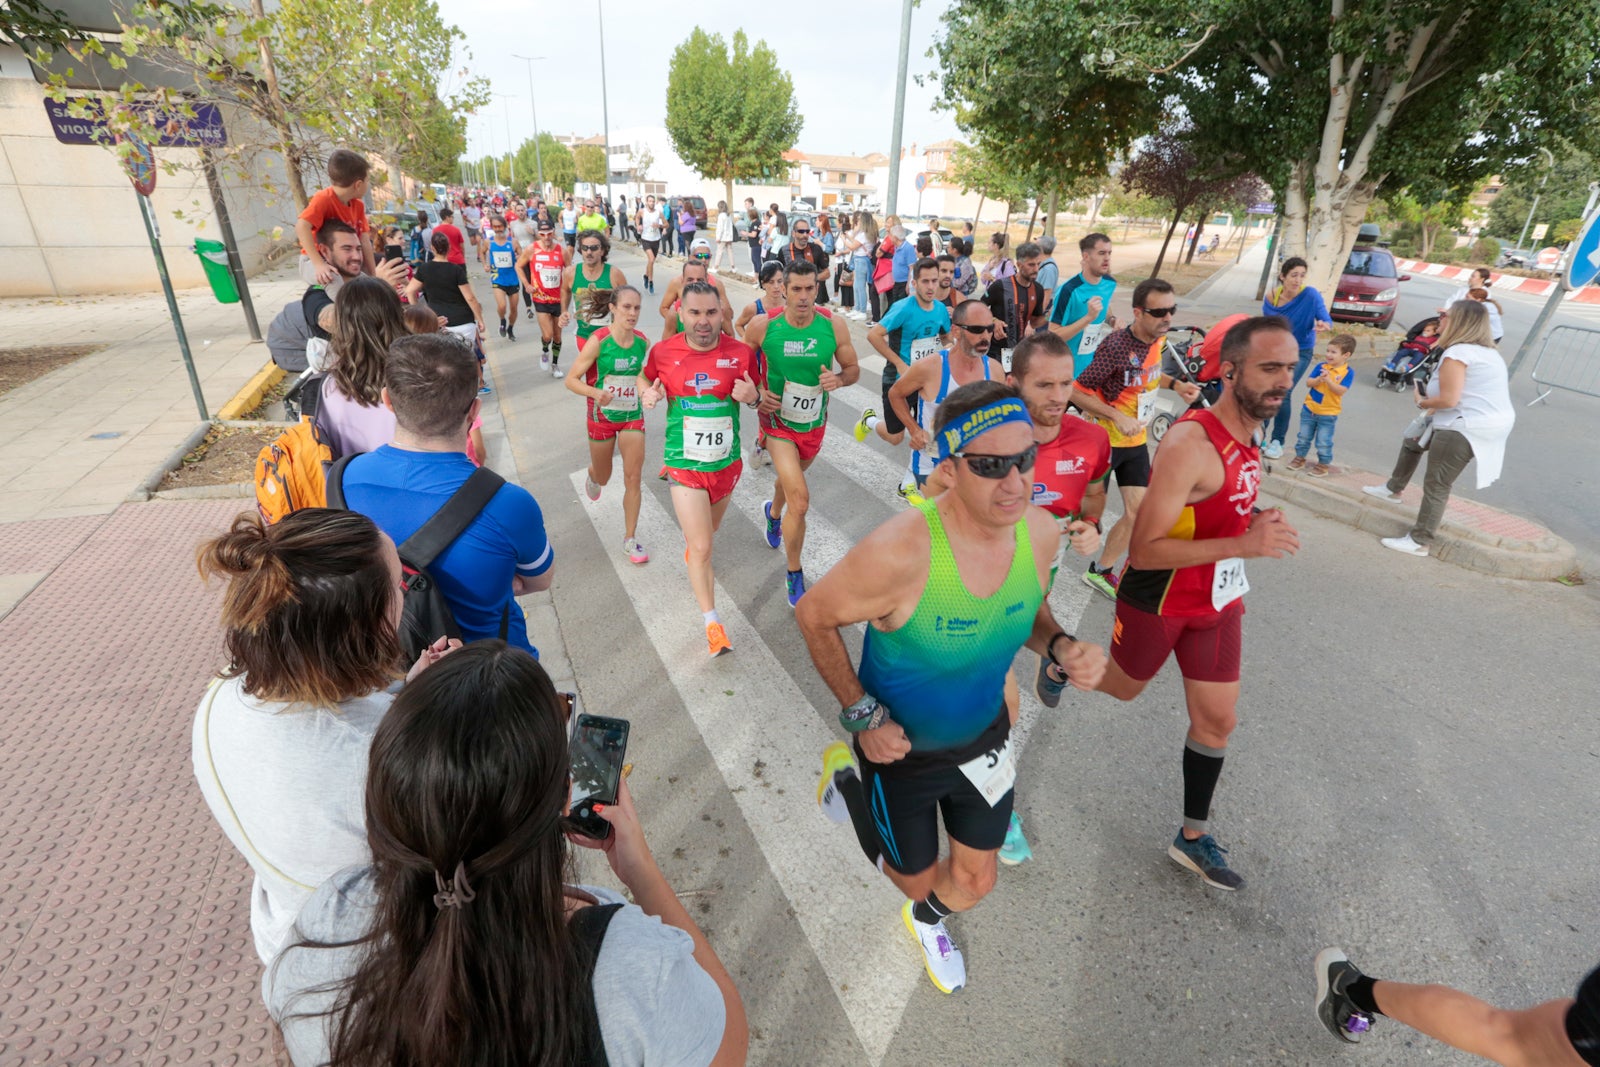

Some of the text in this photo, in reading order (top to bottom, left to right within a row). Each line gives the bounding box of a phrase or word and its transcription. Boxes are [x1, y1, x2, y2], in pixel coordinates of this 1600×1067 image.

[608, 386, 635, 398] 2144
[793, 396, 816, 410] 707
[962, 404, 1022, 432] olimpo
[694, 432, 724, 446] 718
